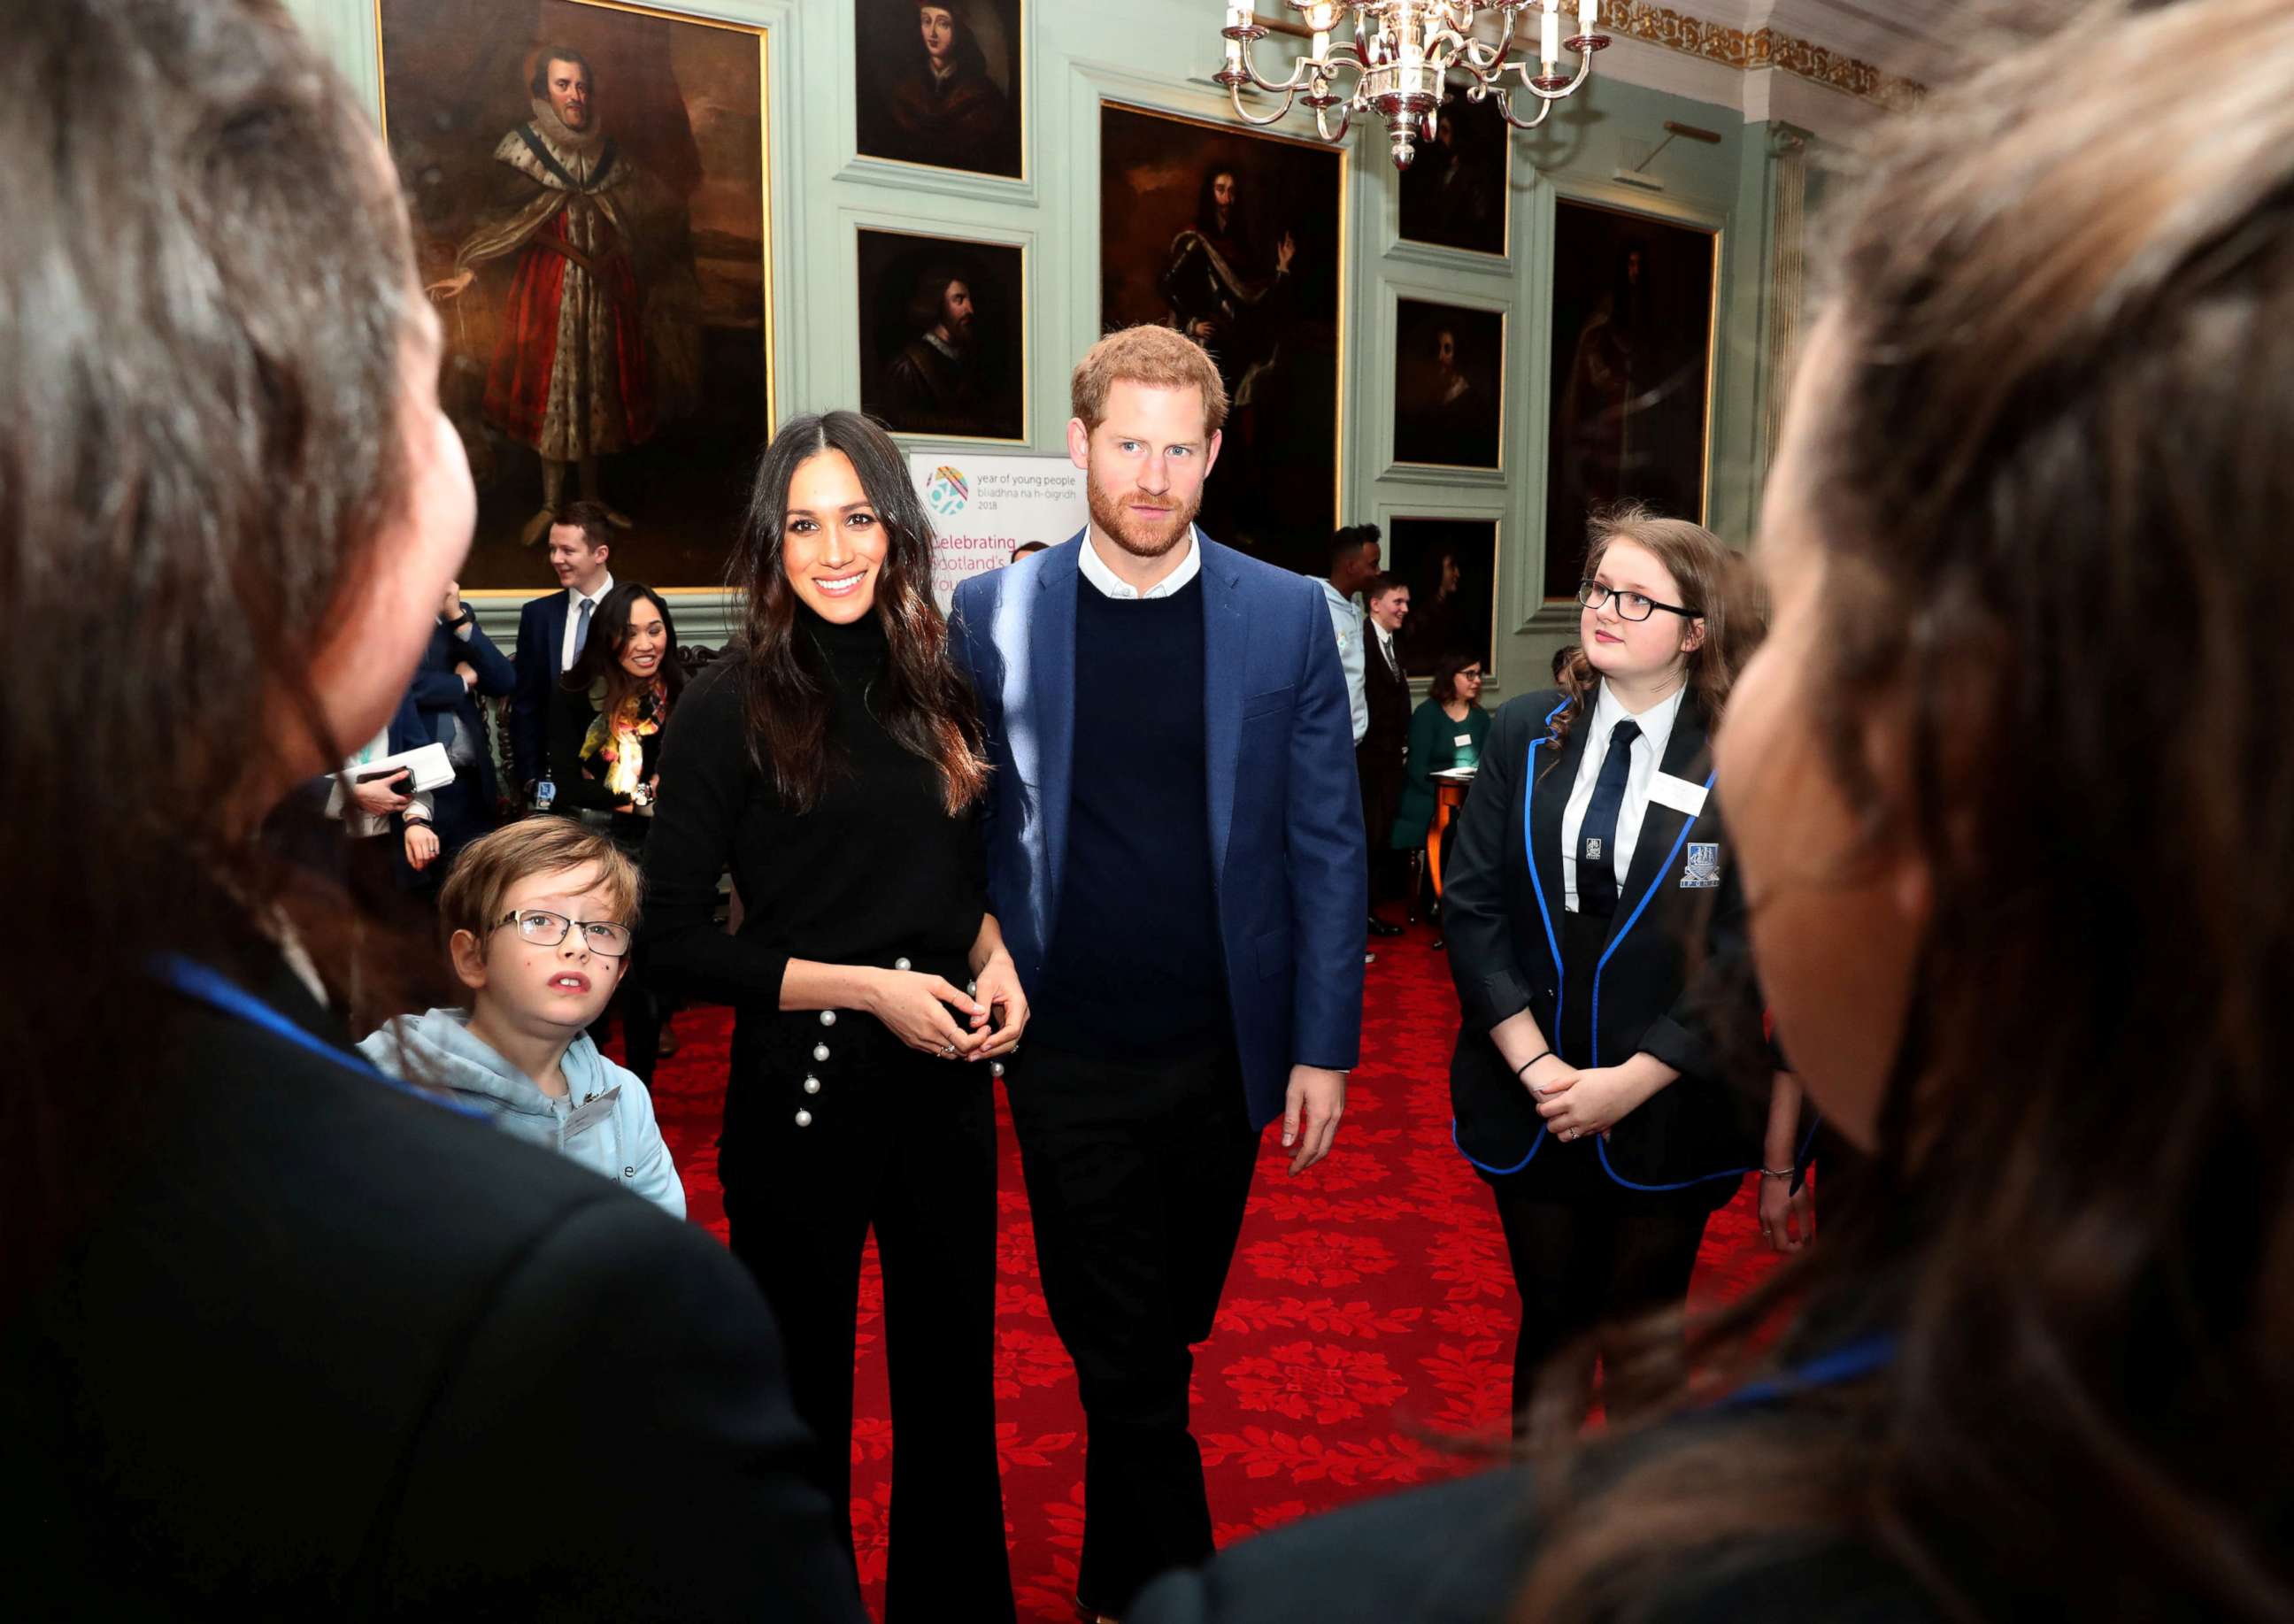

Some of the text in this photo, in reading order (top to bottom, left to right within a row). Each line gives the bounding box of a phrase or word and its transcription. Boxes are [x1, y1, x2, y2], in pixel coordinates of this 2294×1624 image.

[977, 473, 1076, 487] year of young people
[978, 501, 997, 511] 2018
